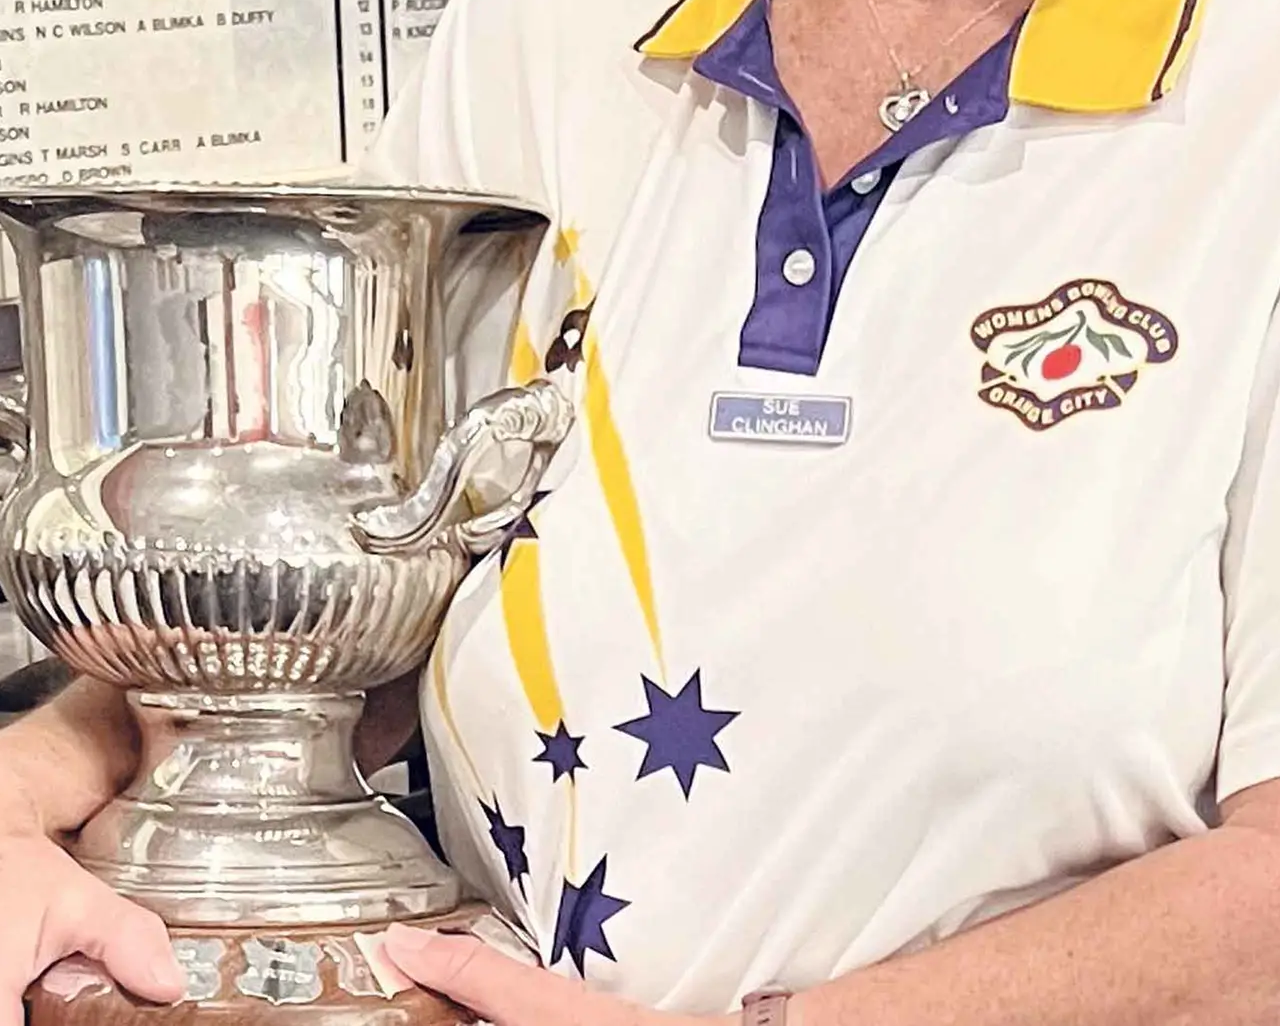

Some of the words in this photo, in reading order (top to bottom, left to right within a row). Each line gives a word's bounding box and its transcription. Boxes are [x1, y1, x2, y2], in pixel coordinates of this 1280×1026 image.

[70, 22, 126, 36] WILSON
[56, 145, 107, 159] MARSH
[140, 139, 180, 155] CARR
[974, 299, 1063, 338] WOMENS
[1129, 312, 1170, 353] CLUB
[763, 400, 799, 415] SUE
[1061, 389, 1108, 415] CITY
[732, 417, 827, 436] CLINGHAN
